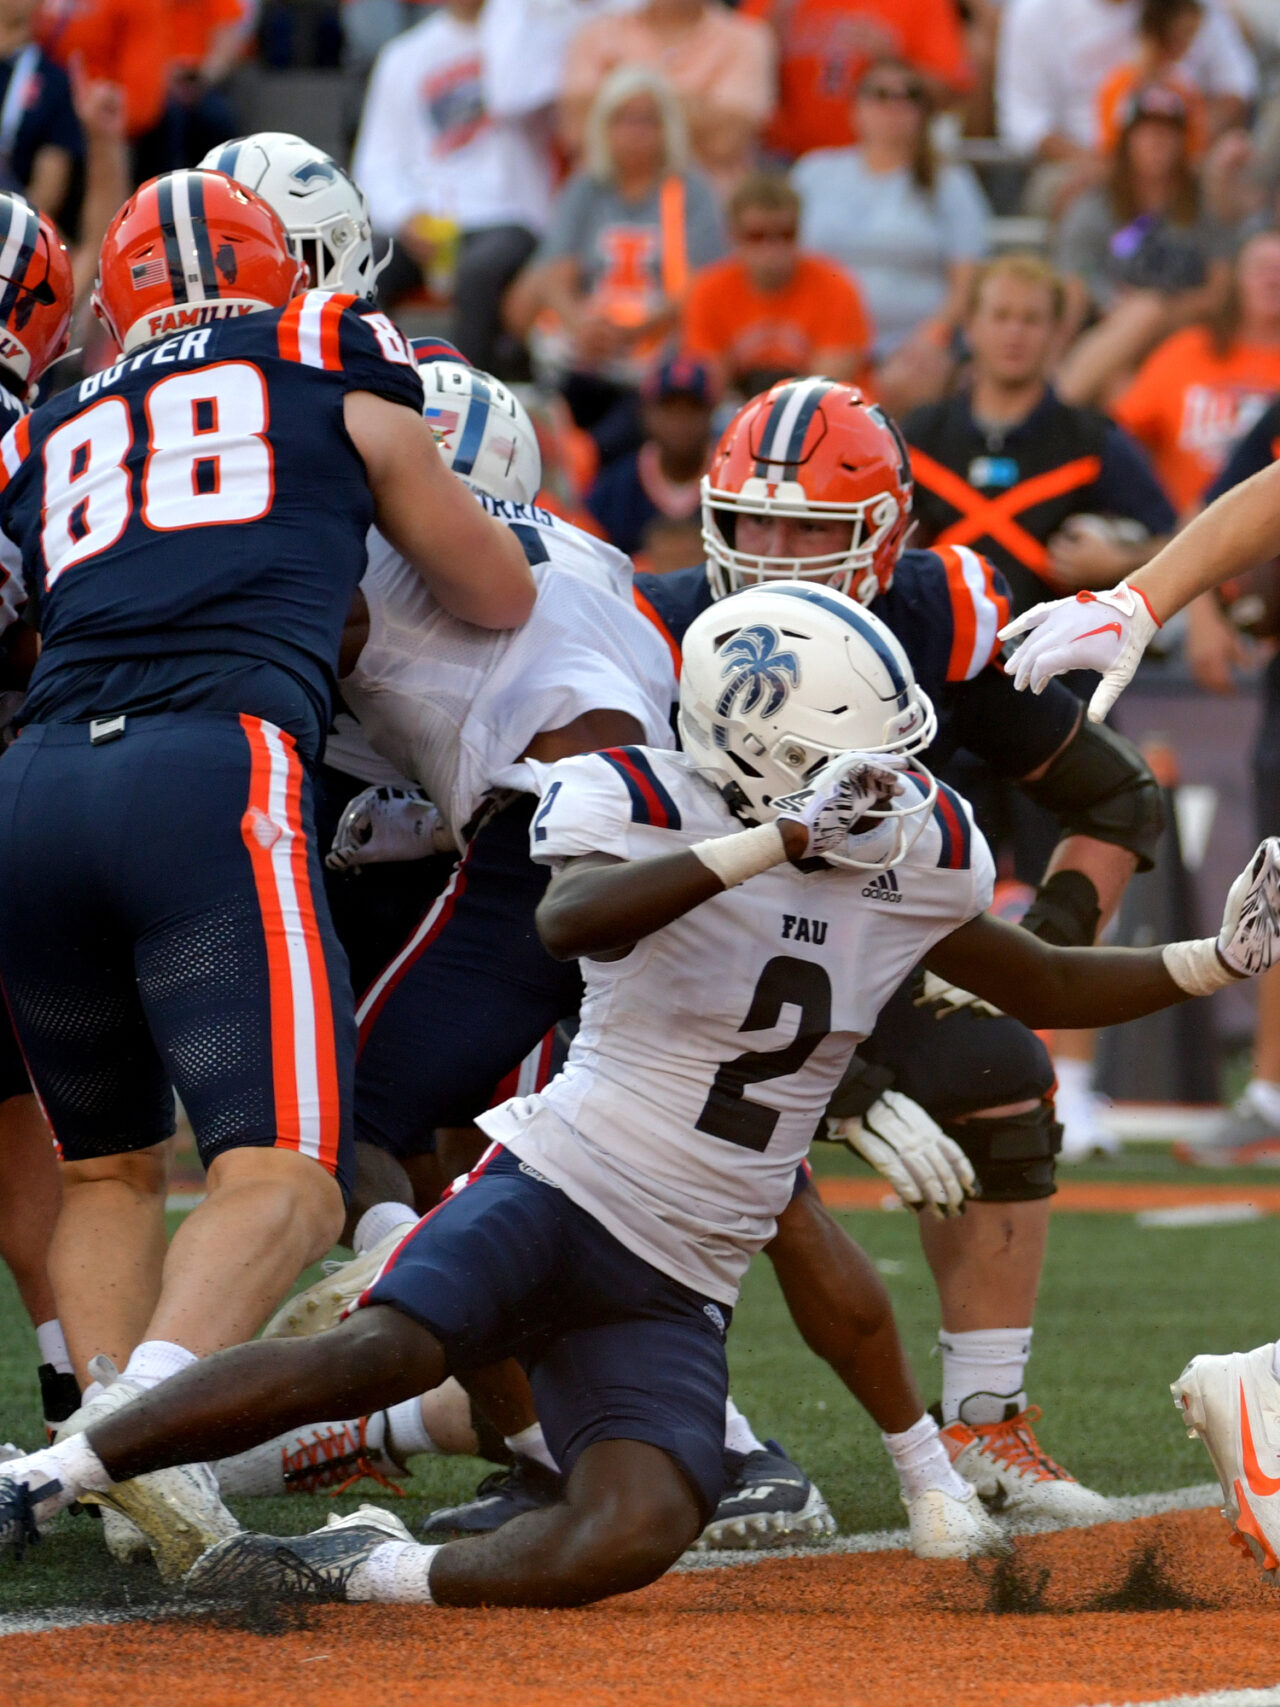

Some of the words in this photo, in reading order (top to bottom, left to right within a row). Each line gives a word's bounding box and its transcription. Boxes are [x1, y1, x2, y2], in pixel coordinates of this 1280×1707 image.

[39, 359, 276, 593] 88
[534, 781, 563, 842] 2
[861, 887, 903, 904] adidas
[781, 913, 829, 946] FAU
[694, 955, 833, 1153] 2
